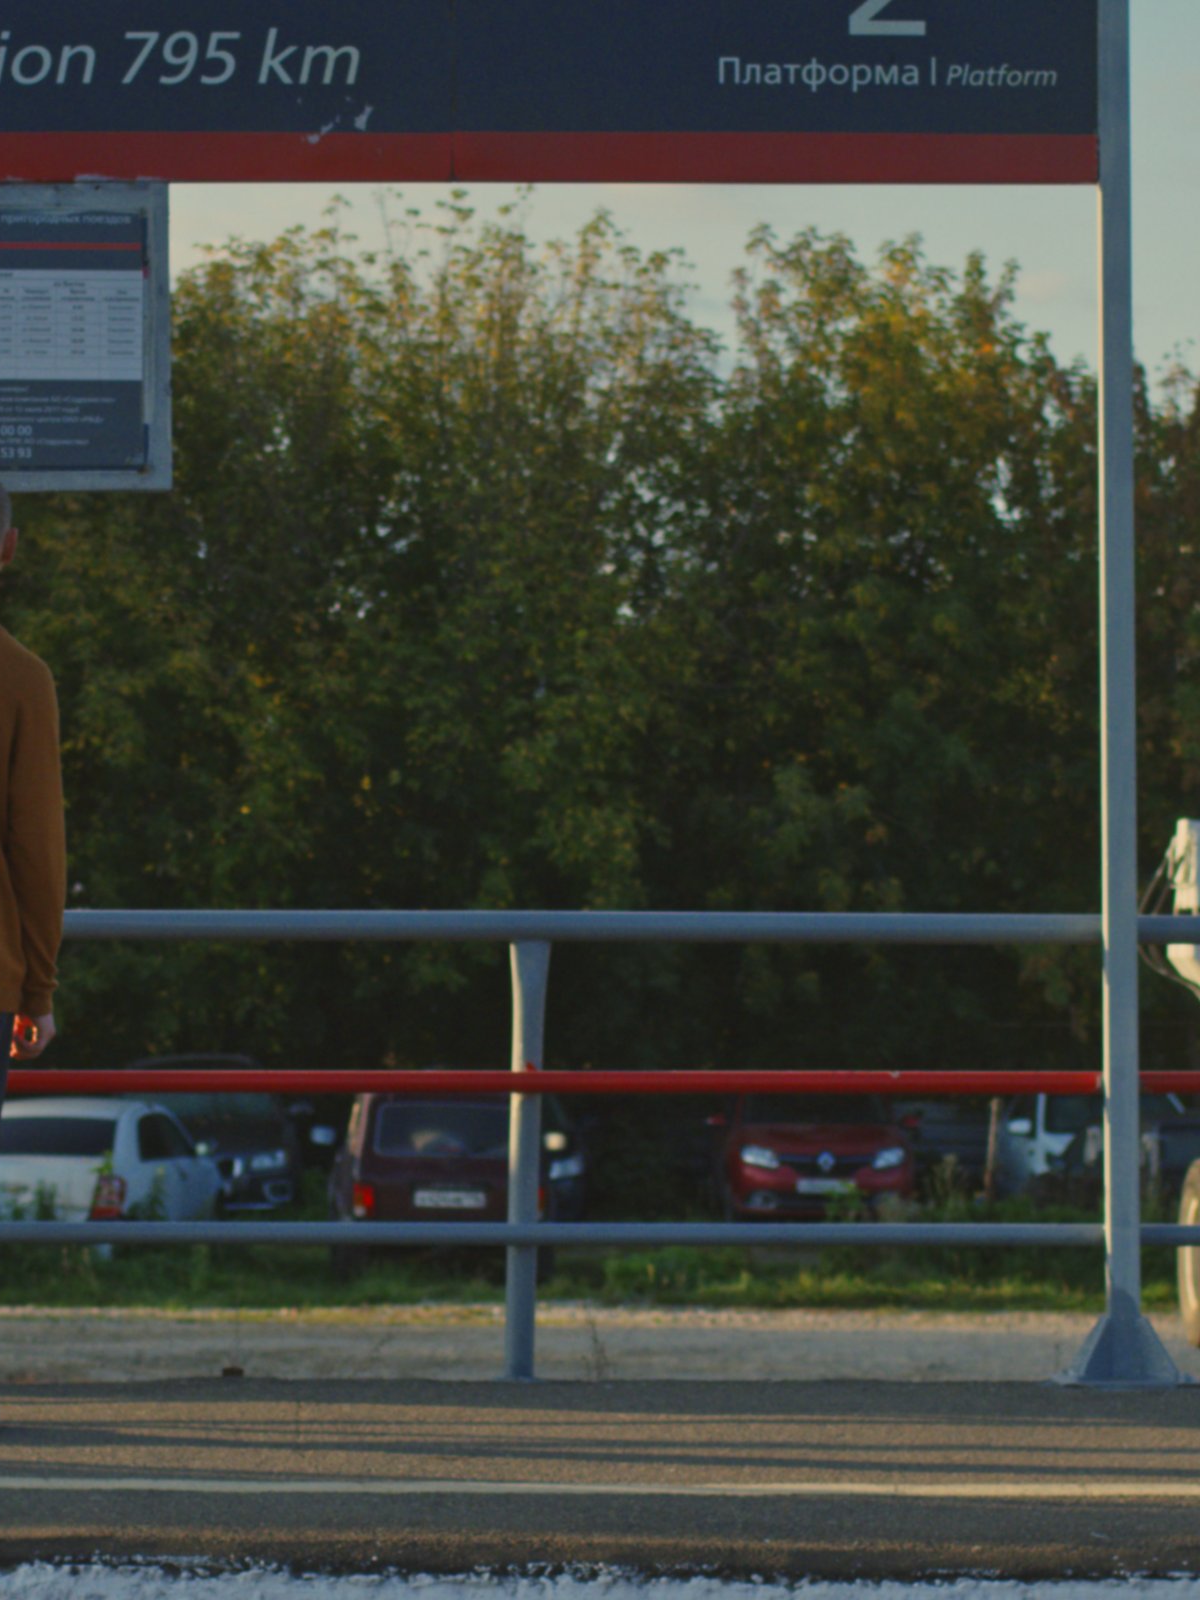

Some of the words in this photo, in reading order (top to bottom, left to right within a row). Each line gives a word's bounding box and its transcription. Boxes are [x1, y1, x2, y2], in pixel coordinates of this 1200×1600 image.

[122, 31, 240, 84] 795
[259, 28, 359, 84] km
[719, 57, 919, 92] Платформа
[947, 64, 1057, 86] Platform
[0, 425, 16, 436] 00
[17, 425, 33, 436] 00
